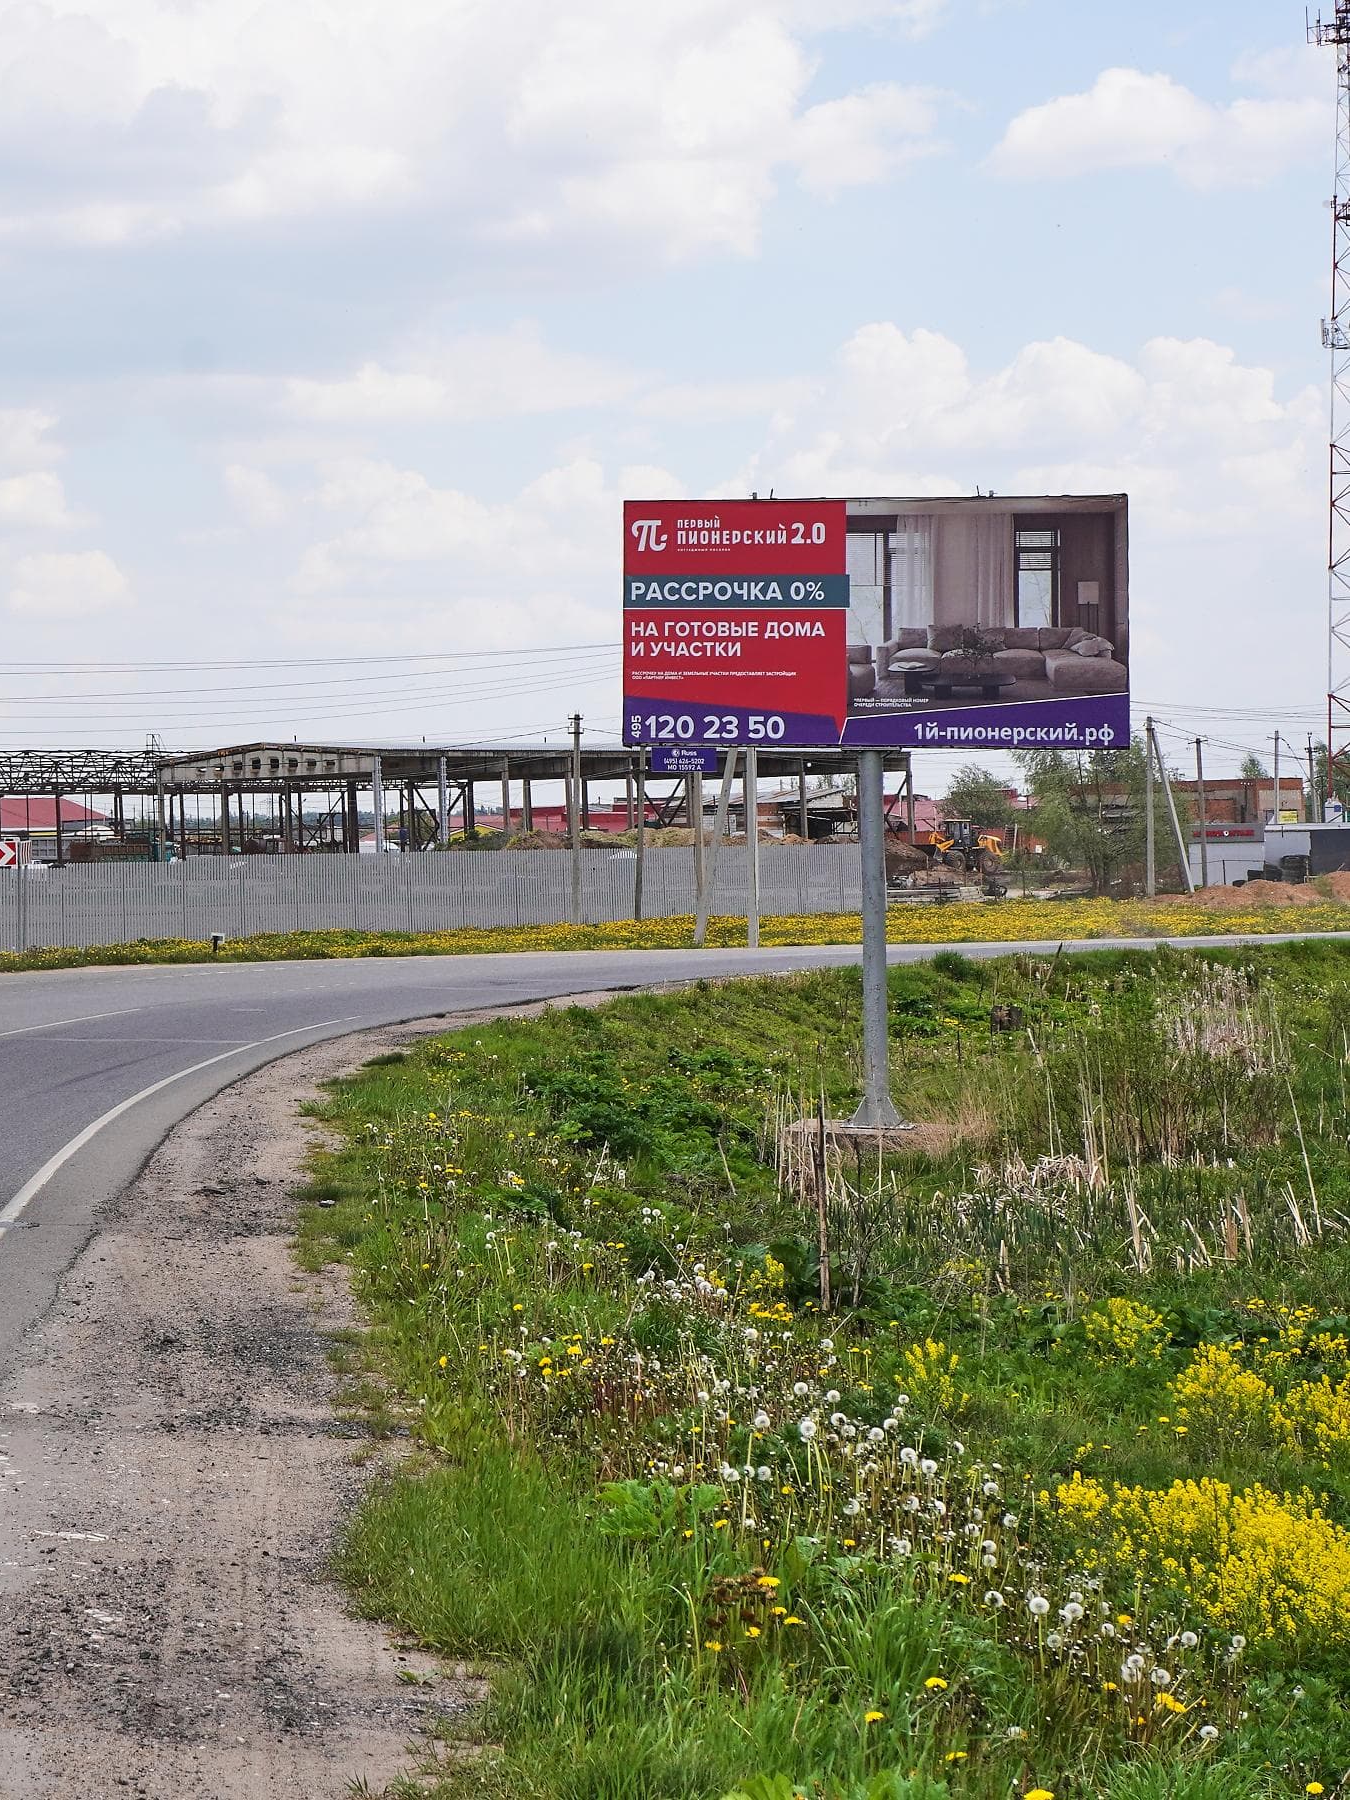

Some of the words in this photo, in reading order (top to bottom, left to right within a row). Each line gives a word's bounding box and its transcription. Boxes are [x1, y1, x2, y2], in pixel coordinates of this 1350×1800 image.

[677, 515, 721, 529] ПЕРВЫЙ
[677, 523, 787, 545] ПИОНЕРСКИЙ
[791, 522, 826, 545] 2.0
[631, 581, 783, 601] РАССРОЧКА
[790, 581, 825, 601] 0%
[631, 621, 659, 637] НА
[664, 621, 759, 637] ГОТОВЫЕ
[764, 621, 826, 639] ДОМА
[631, 642, 645, 657] И
[650, 641, 741, 657] УЧАСТКИ
[631, 714, 642, 738] 495
[645, 715, 695, 739] 120
[703, 715, 739, 739] 23
[747, 715, 786, 739] 50
[914, 722, 1115, 746] 1й-пионерский.рф
